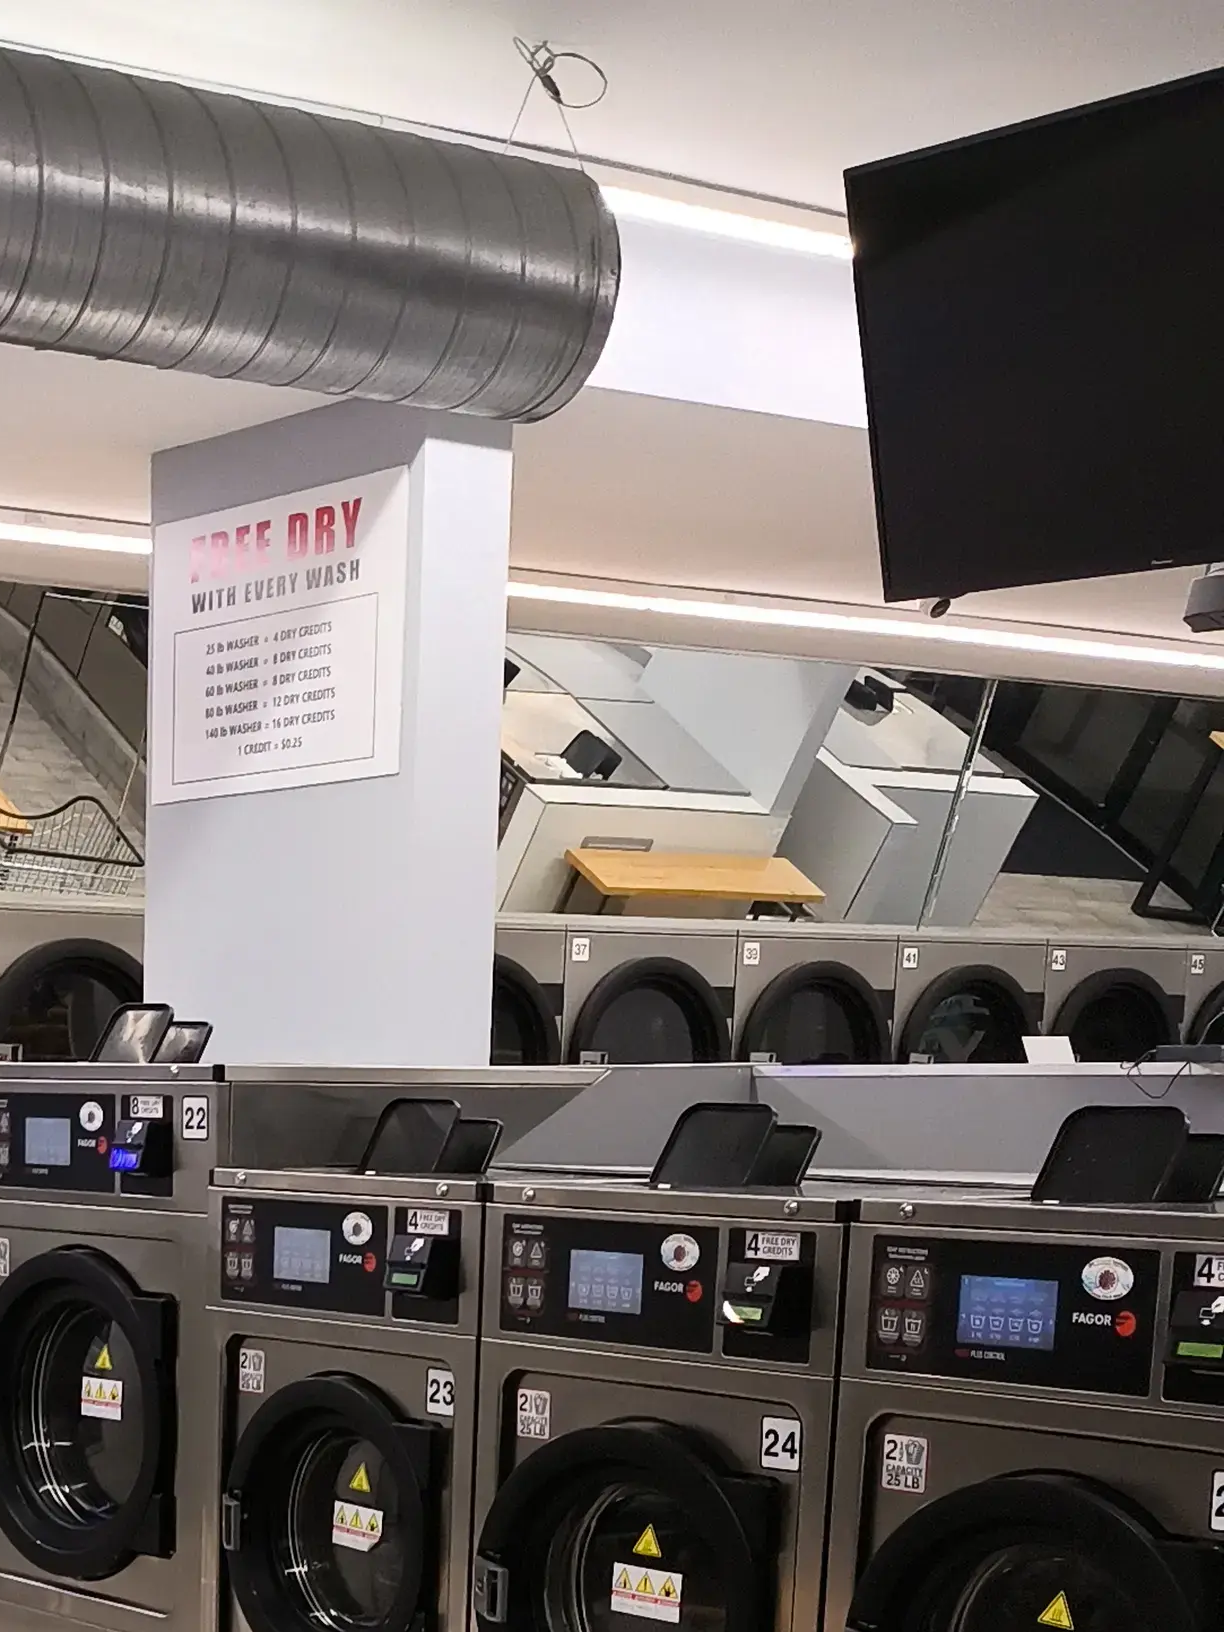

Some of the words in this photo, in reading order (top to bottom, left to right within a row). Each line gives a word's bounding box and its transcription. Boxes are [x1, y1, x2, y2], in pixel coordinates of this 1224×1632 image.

[190, 519, 271, 584] FREE
[286, 497, 363, 561] DRY
[191, 585, 236, 614] WITH
[244, 572, 298, 603] EVERY
[306, 559, 360, 590] WASH
[226, 635, 259, 651] WASHER
[273, 632, 278, 642] 4
[280, 628, 297, 641] DRY
[299, 621, 332, 638] CREDITS
[226, 657, 259, 672] WASHER
[280, 650, 296, 663] DRY
[298, 643, 332, 659] CREDITS
[205, 686, 215, 697] 60
[225, 679, 258, 694] WASHER
[279, 672, 295, 685] DRY
[297, 666, 331, 682] CREDITS
[225, 700, 258, 715] WASHER
[272, 696, 281, 707] 12
[283, 693, 300, 706] DRY
[302, 687, 336, 703] CREDITS
[205, 727, 218, 739] 140
[229, 721, 262, 736] WASHER
[272, 717, 281, 729] 16
[283, 714, 300, 727] DRY
[301, 709, 335, 725] CREDITS
[244, 741, 271, 756] CREDIT
[281, 736, 302, 750] $0.25
[574, 943, 587, 956] 37
[745, 947, 758, 960] 39
[905, 952, 917, 964] 41
[1052, 954, 1066, 966] 43
[131, 1096, 139, 1115] 8
[184, 1106, 207, 1130] 22
[408, 1210, 419, 1231] 4
[747, 1233, 760, 1256] 4
[761, 1236, 779, 1246] FREE
[780, 1237, 797, 1247] DRY
[762, 1246, 793, 1256] CREDITS
[339, 1252, 362, 1265] FAGOR
[1197, 1256, 1215, 1284] 4
[654, 1280, 684, 1294] FAGOR
[1071, 1312, 1112, 1327] FAGOR
[240, 1352, 248, 1369] 2
[429, 1378, 455, 1406] 23
[519, 1393, 529, 1412] 2
[519, 1423, 532, 1436] 25
[533, 1423, 546, 1436] LB
[763, 1428, 798, 1460] 24
[885, 1439, 898, 1460] 2
[886, 1463, 923, 1478] CAPACITY
[886, 1473, 901, 1487] 25
[904, 1475, 920, 1489] LB
